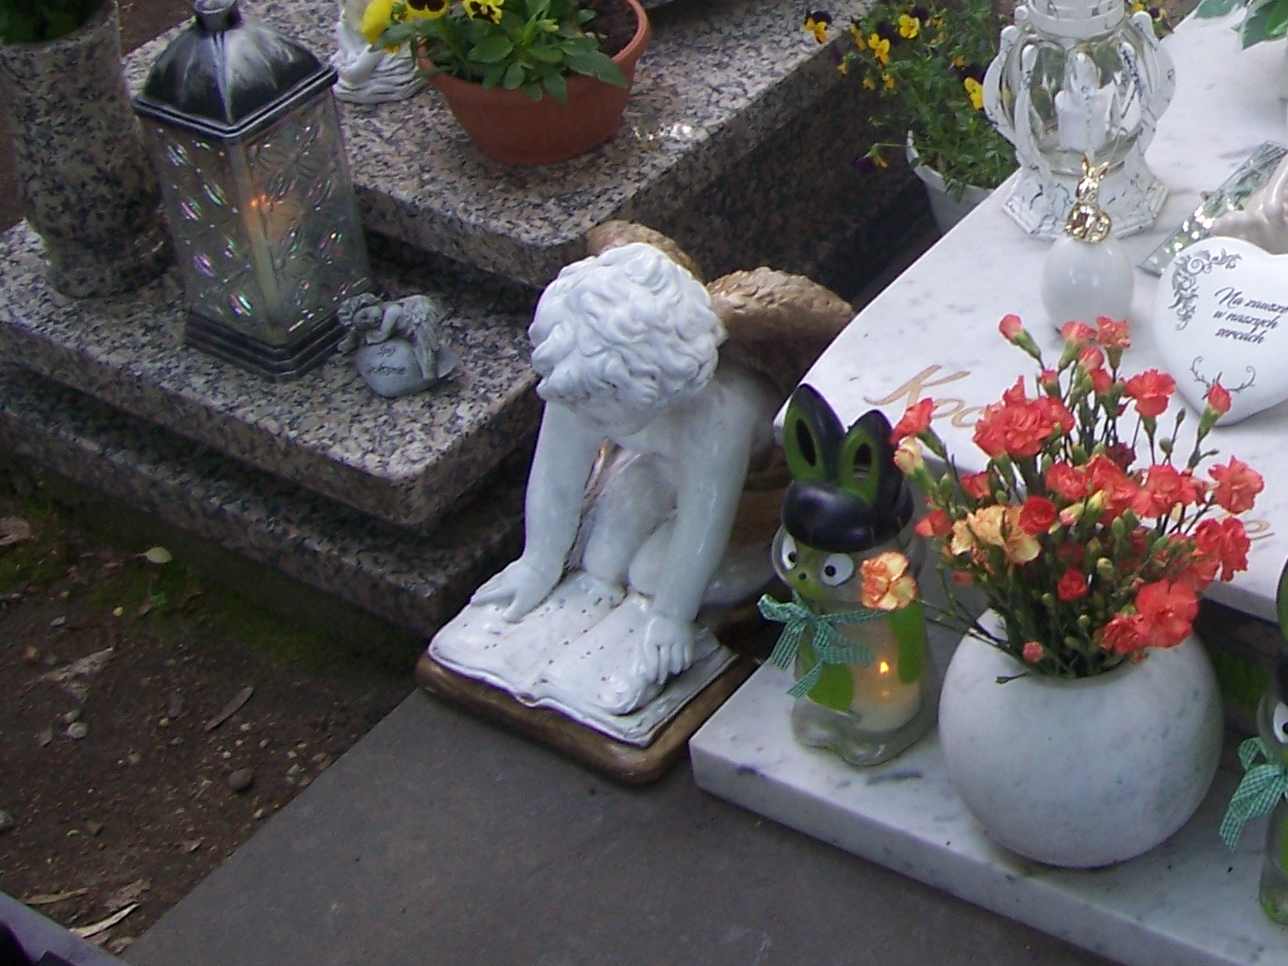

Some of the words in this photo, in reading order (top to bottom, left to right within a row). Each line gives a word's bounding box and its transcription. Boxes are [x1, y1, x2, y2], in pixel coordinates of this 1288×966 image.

[1214, 287, 1244, 309] Na
[1212, 310, 1227, 320] w
[1225, 313, 1281, 335] naszych
[1215, 327, 1268, 345] sercach
